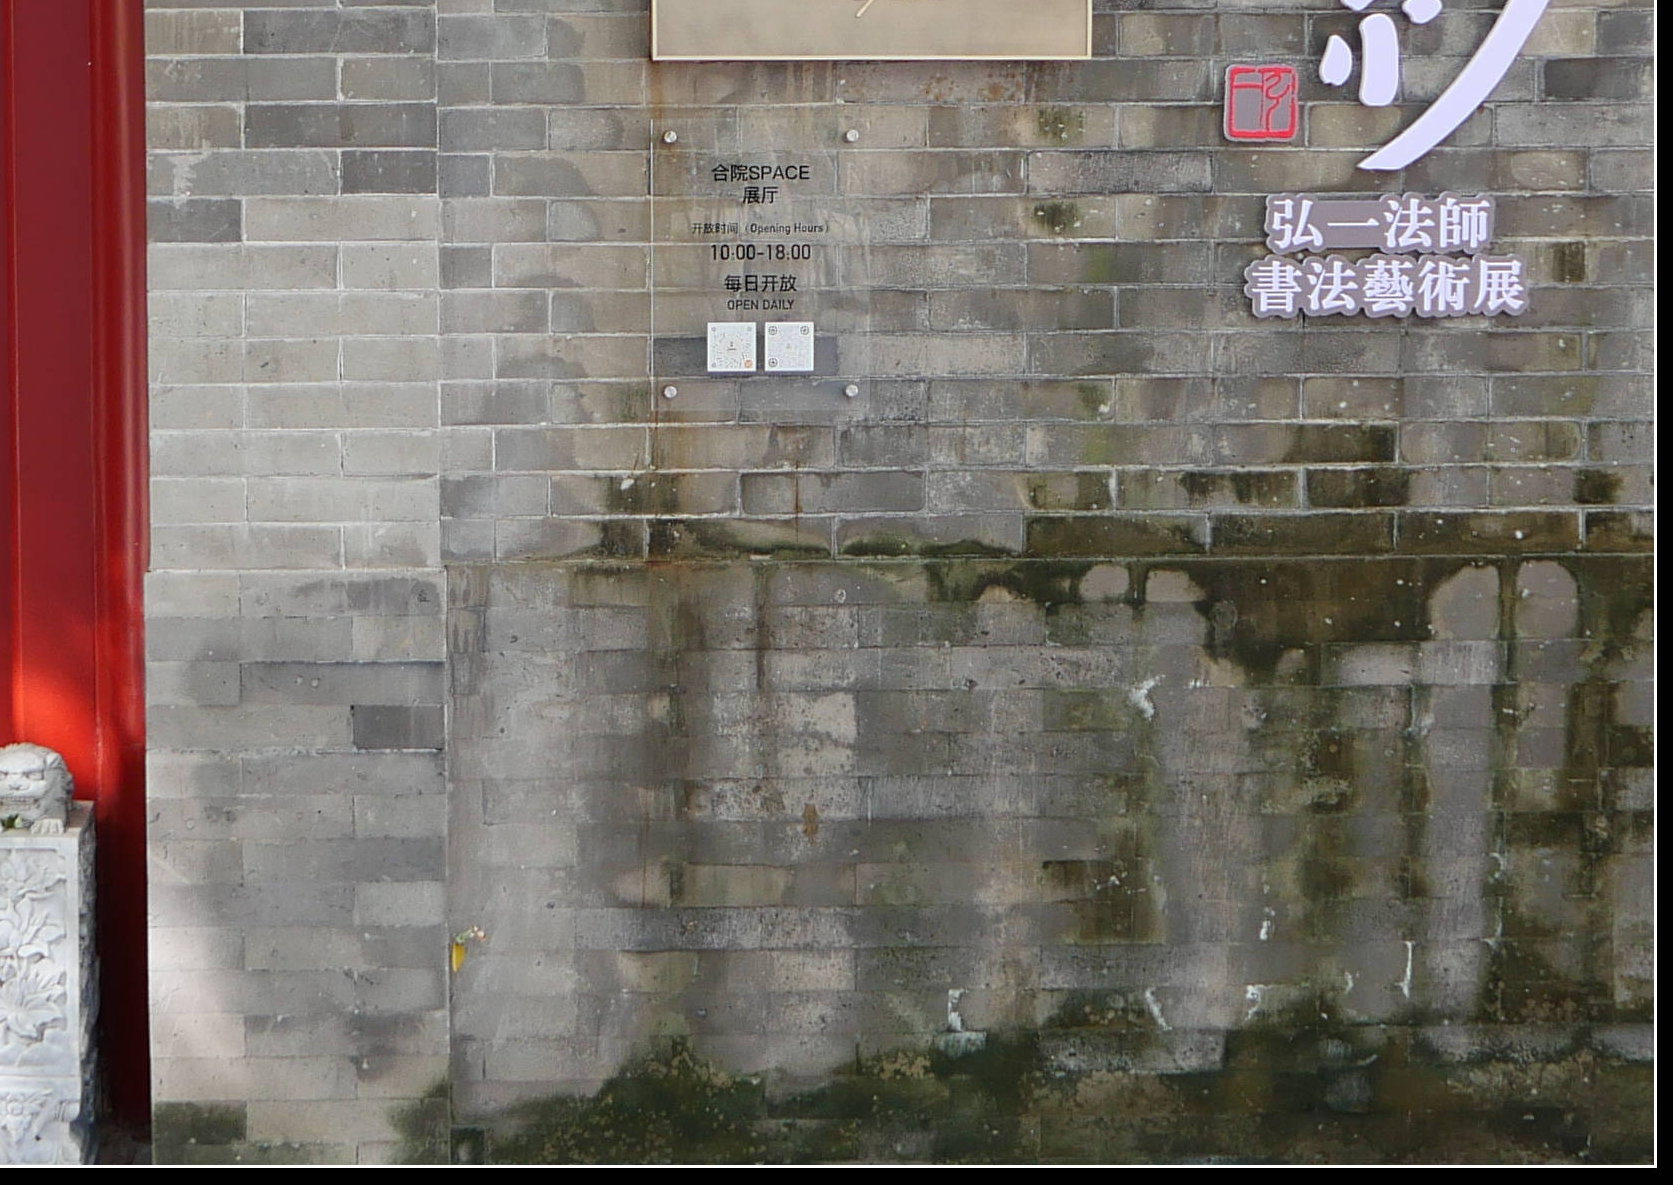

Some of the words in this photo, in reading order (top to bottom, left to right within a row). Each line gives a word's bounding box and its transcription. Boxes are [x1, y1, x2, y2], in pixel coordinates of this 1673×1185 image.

[711, 163, 810, 182] 合院SPACE
[742, 186, 779, 205] 展厅
[1270, 198, 1491, 250] 弘一法師
[710, 244, 811, 261] 10:00-18:00
[723, 274, 797, 293] 每日开放
[1252, 259, 1526, 314] 書法藝術展
[727, 299, 759, 311] OPEN
[762, 299, 795, 311] DAILY
